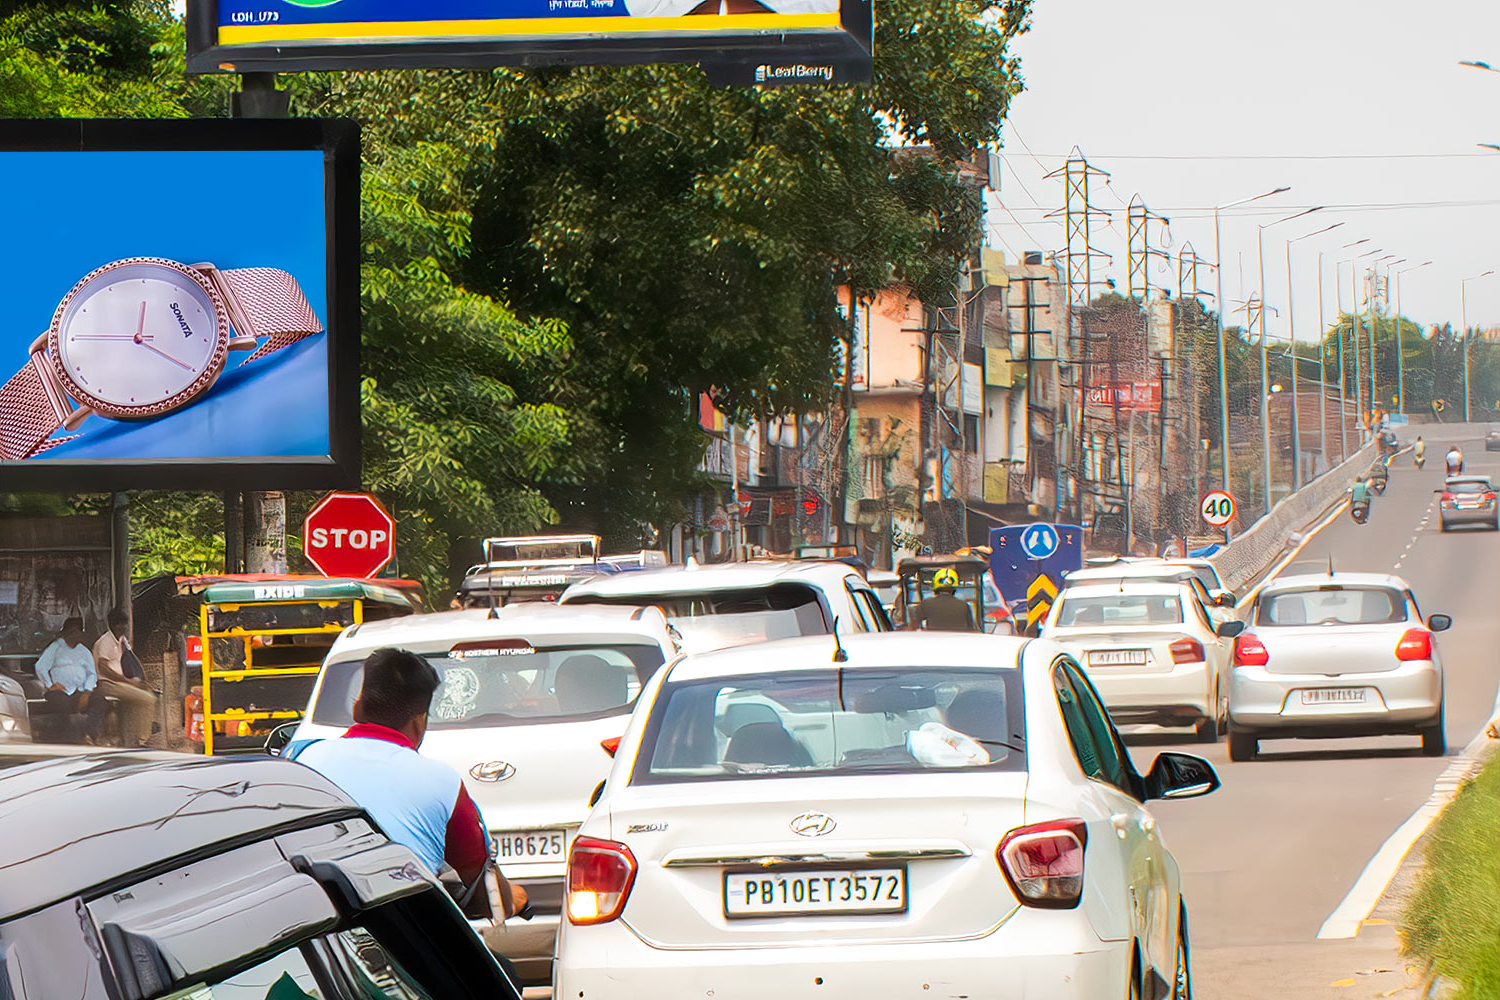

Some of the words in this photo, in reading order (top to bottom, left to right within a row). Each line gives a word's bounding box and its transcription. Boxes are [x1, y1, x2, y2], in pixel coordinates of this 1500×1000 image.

[169, 302, 193, 339] SONATA
[1204, 498, 1231, 517] 40
[311, 528, 387, 550] STOP
[745, 876, 899, 905] PB10ET3572
